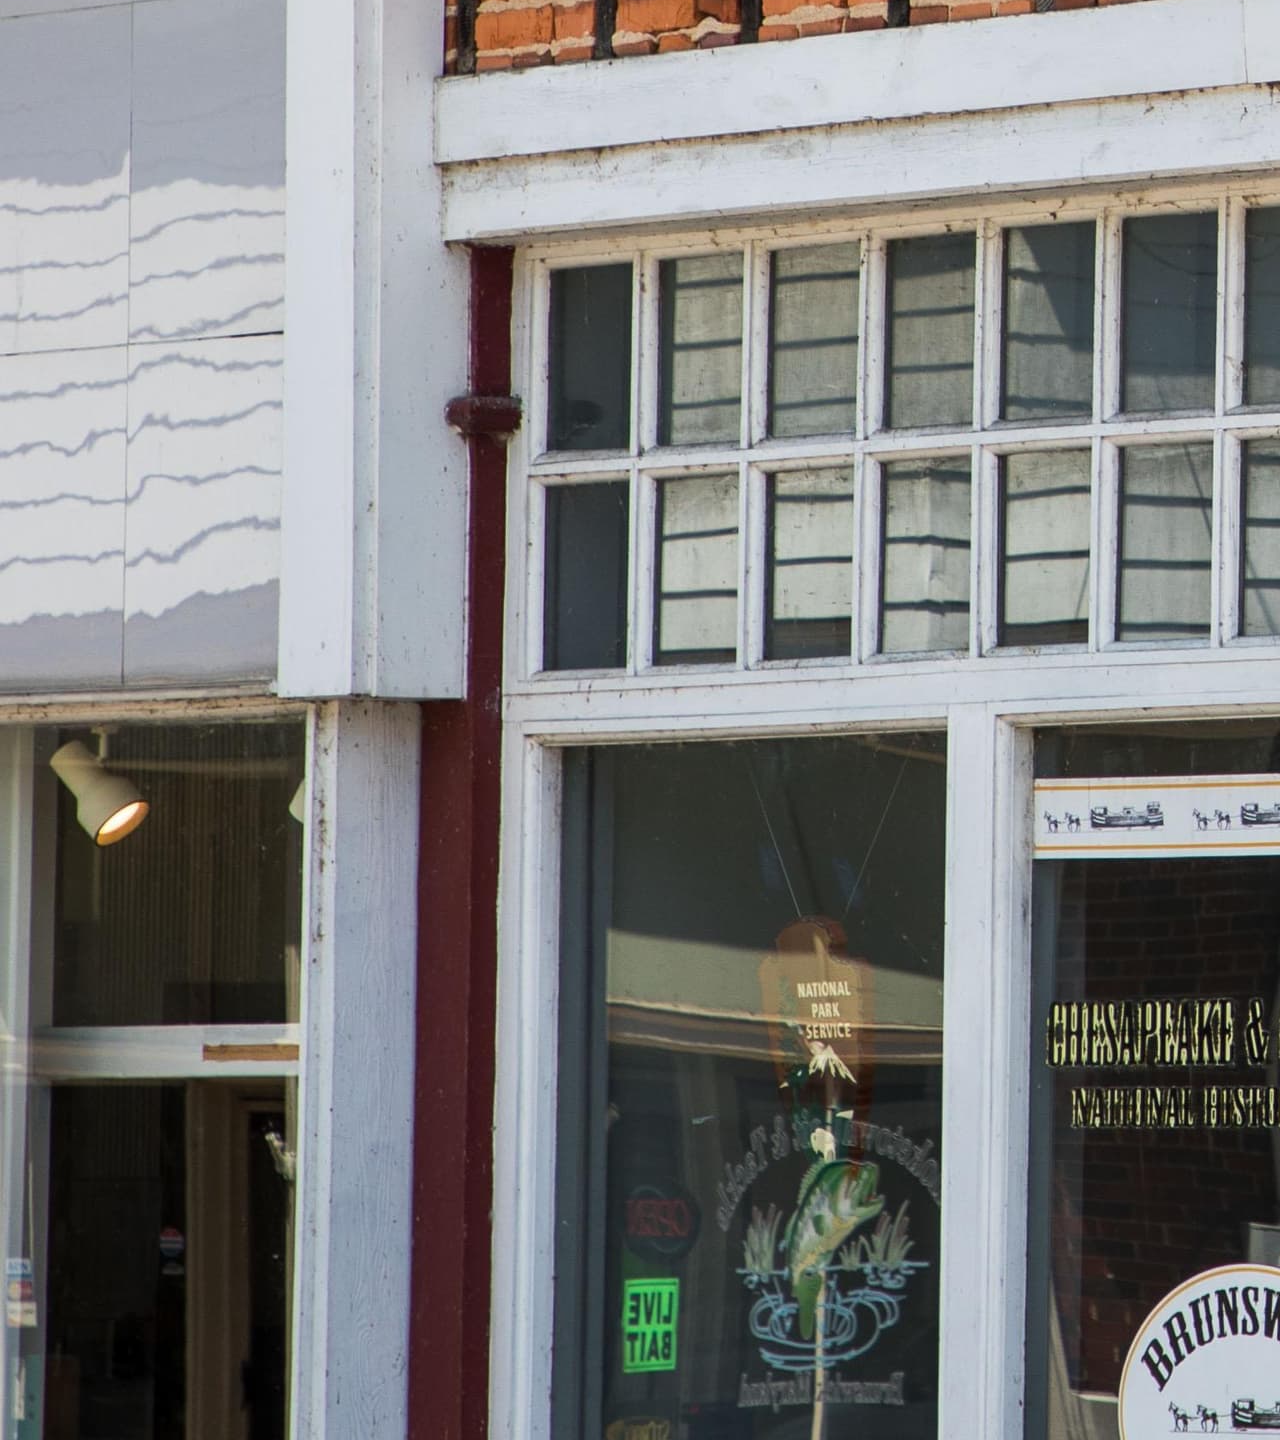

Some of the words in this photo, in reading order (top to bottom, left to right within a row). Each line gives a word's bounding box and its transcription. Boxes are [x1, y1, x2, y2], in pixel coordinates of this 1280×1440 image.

[797, 981, 851, 998] NATIONAL
[811, 1002, 840, 1018] PARK
[805, 1022, 851, 1039] SERVICE
[1045, 1000, 1236, 1066] CHESAPEAKE
[1244, 998, 1269, 1066] &
[1071, 1086, 1194, 1129] NATIONAL
